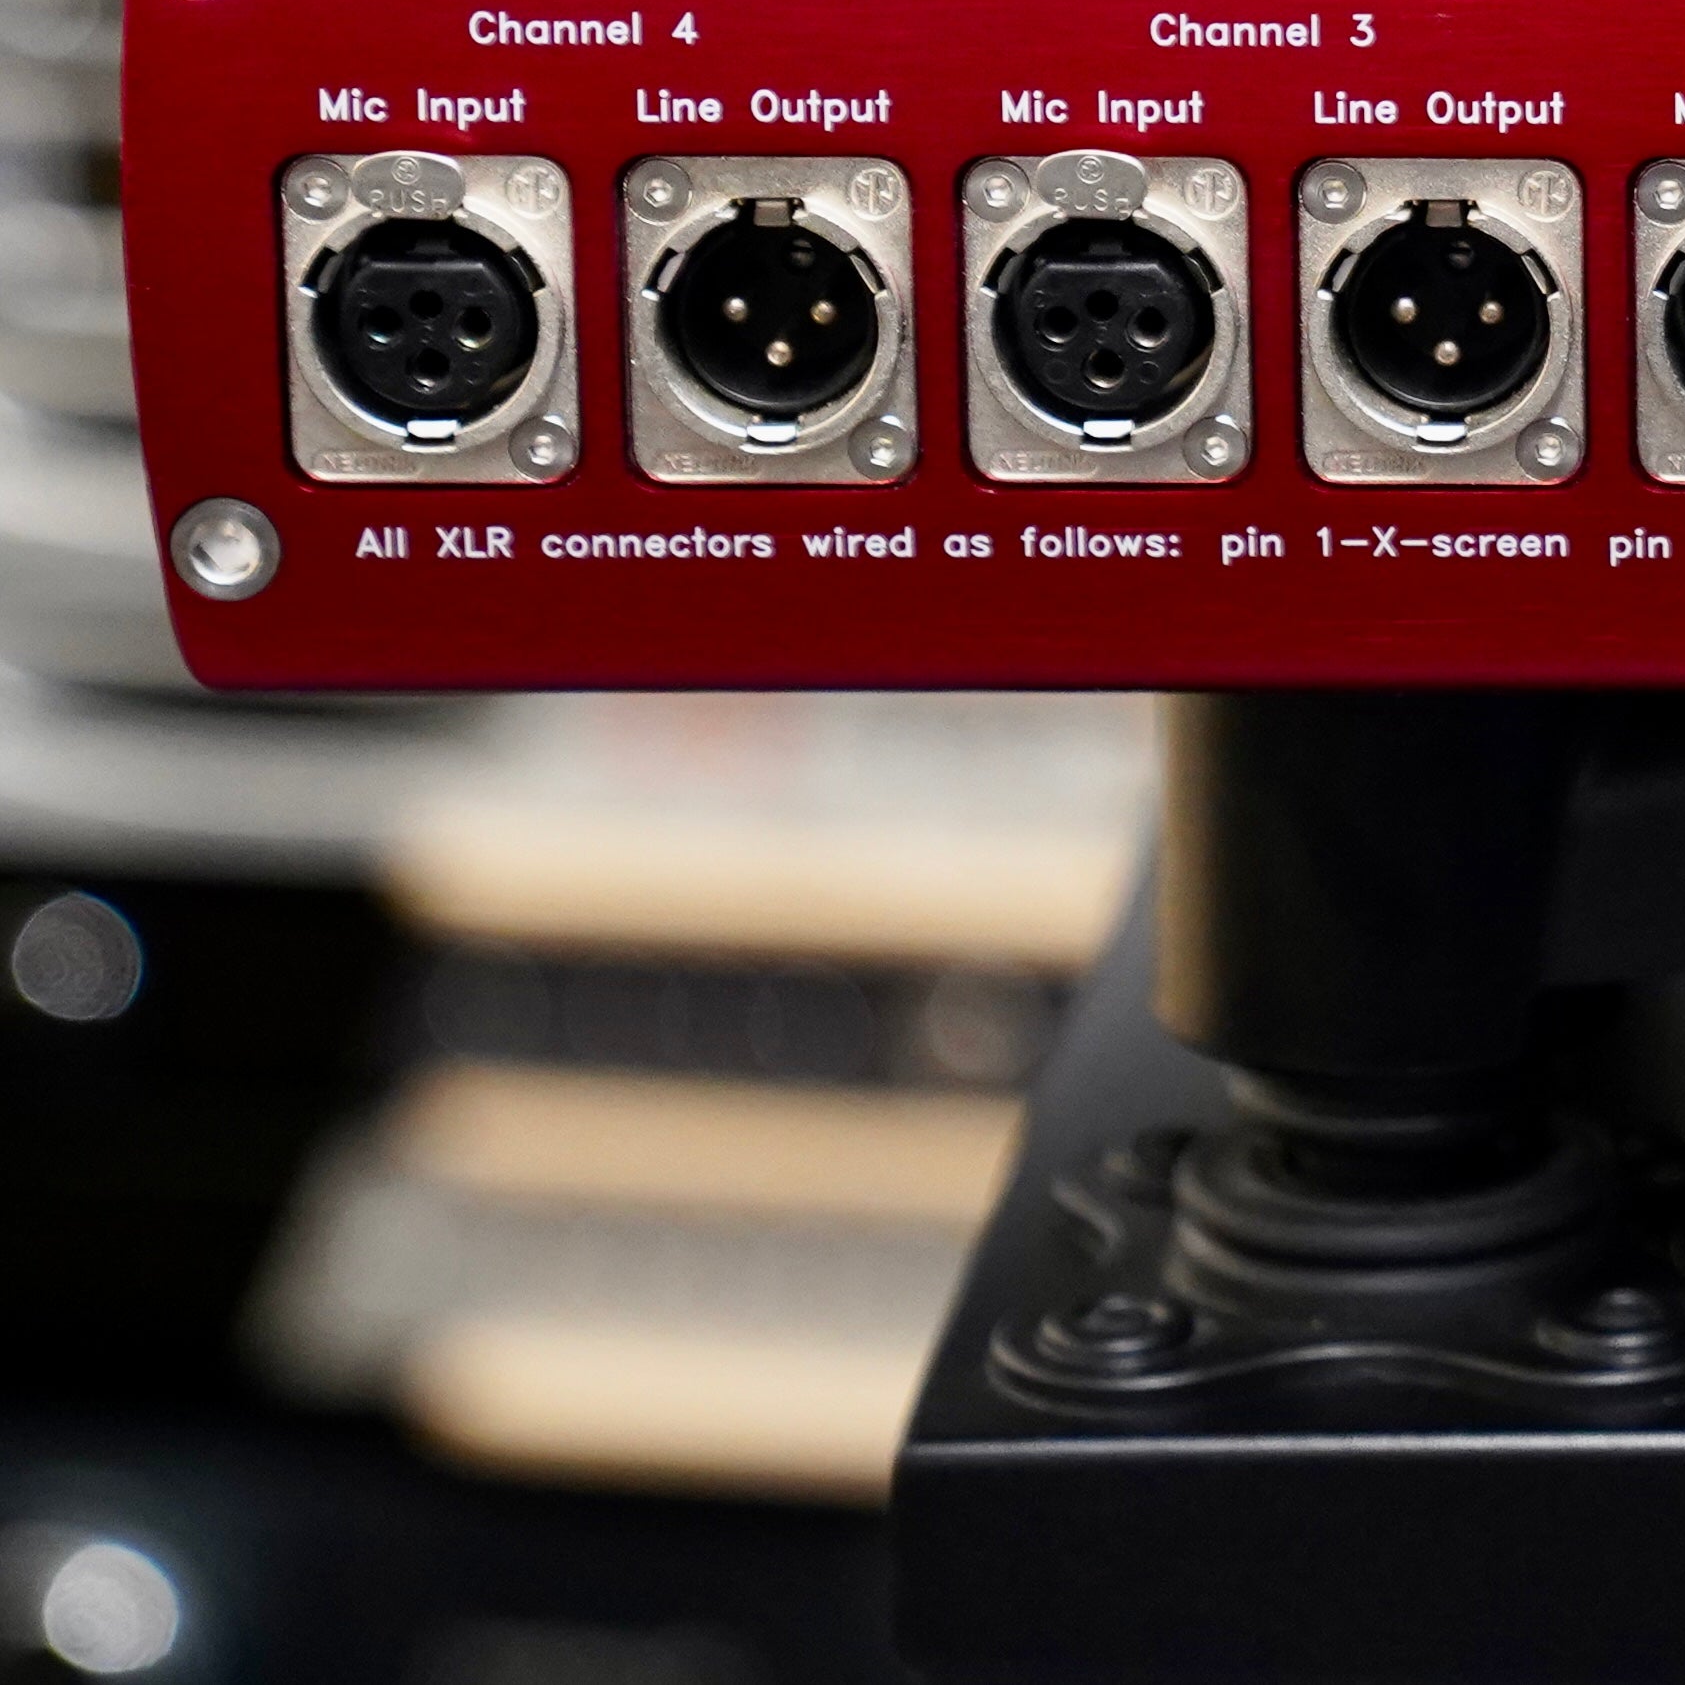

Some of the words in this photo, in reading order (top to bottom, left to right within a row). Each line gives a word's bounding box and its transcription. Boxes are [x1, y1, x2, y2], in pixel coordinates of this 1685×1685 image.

[468, 10, 642, 45] Channel
[671, 11, 699, 45] 4
[1150, 12, 1320, 47] Channel
[1349, 13, 1375, 48] 3
[319, 87, 387, 122] Mic
[417, 88, 526, 131] Input
[636, 88, 723, 123] Line
[750, 88, 891, 132] Output
[1001, 89, 1068, 124] Mic
[1098, 90, 1204, 133] Input
[1314, 90, 1398, 125] Line
[1426, 90, 1565, 134] Output
[355, 526, 406, 558] All
[435, 526, 512, 559] XLR
[541, 526, 773, 559] connectors
[802, 526, 914, 558] wired
[943, 534, 992, 558] as
[1020, 526, 1180, 558] follows:
[1221, 526, 1284, 566] pin
[1316, 526, 1568, 558] 1-X-screen
[1609, 527, 1670, 567] pin
